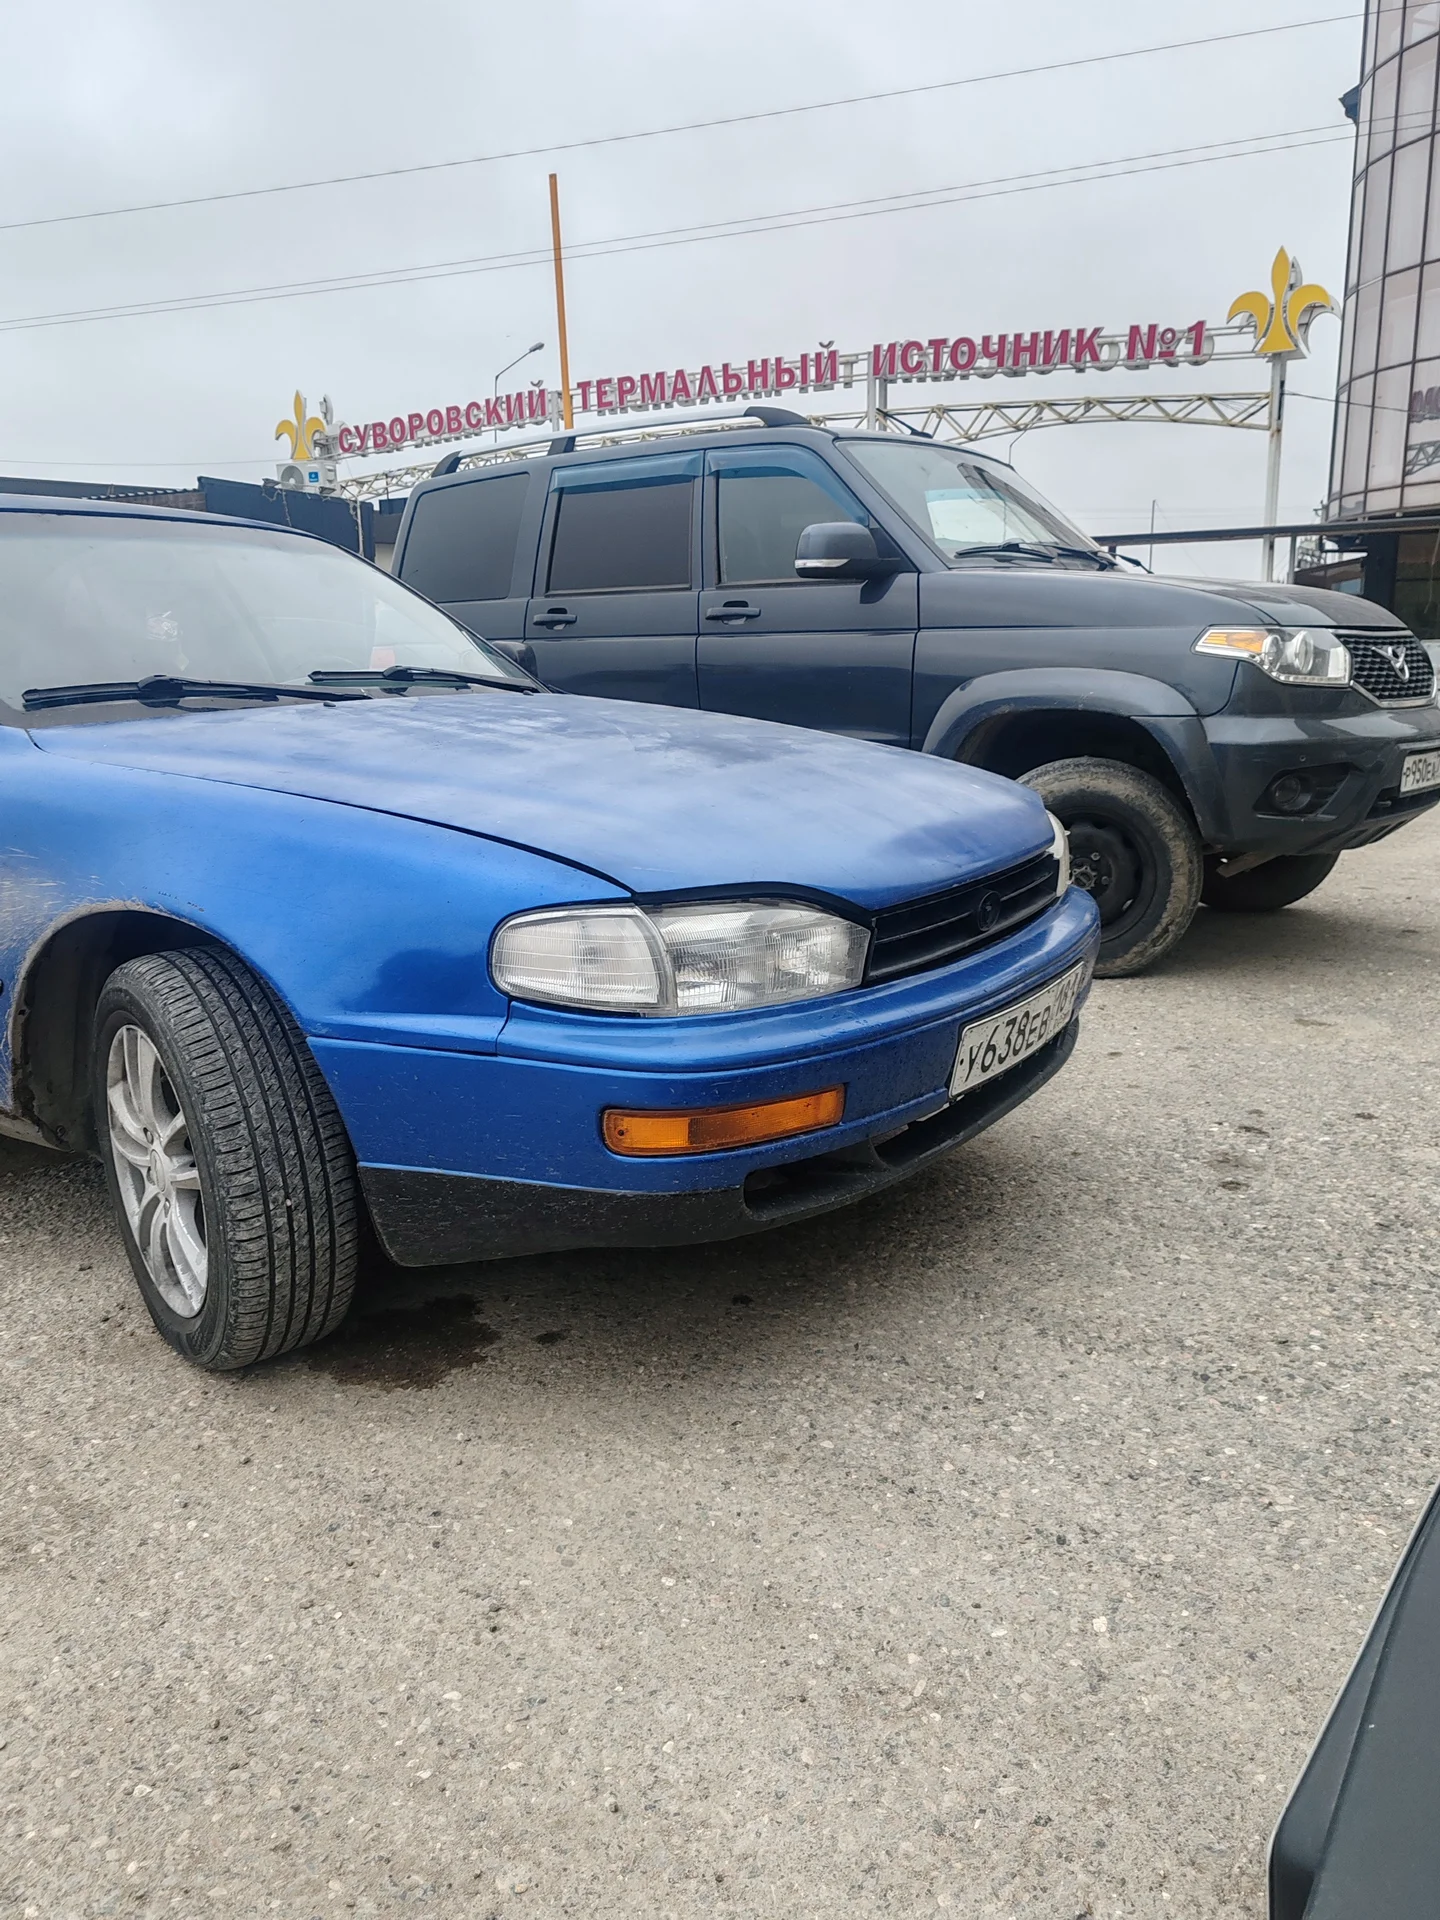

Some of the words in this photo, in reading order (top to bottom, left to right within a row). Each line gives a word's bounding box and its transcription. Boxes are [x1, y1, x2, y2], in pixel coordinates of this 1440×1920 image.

[337, 379, 549, 454] СУВОРОВСКИЙ
[576, 340, 839, 411] ТЕРМАЛЬНЫЙ
[872, 327, 1102, 378] ИСТОЧНИК
